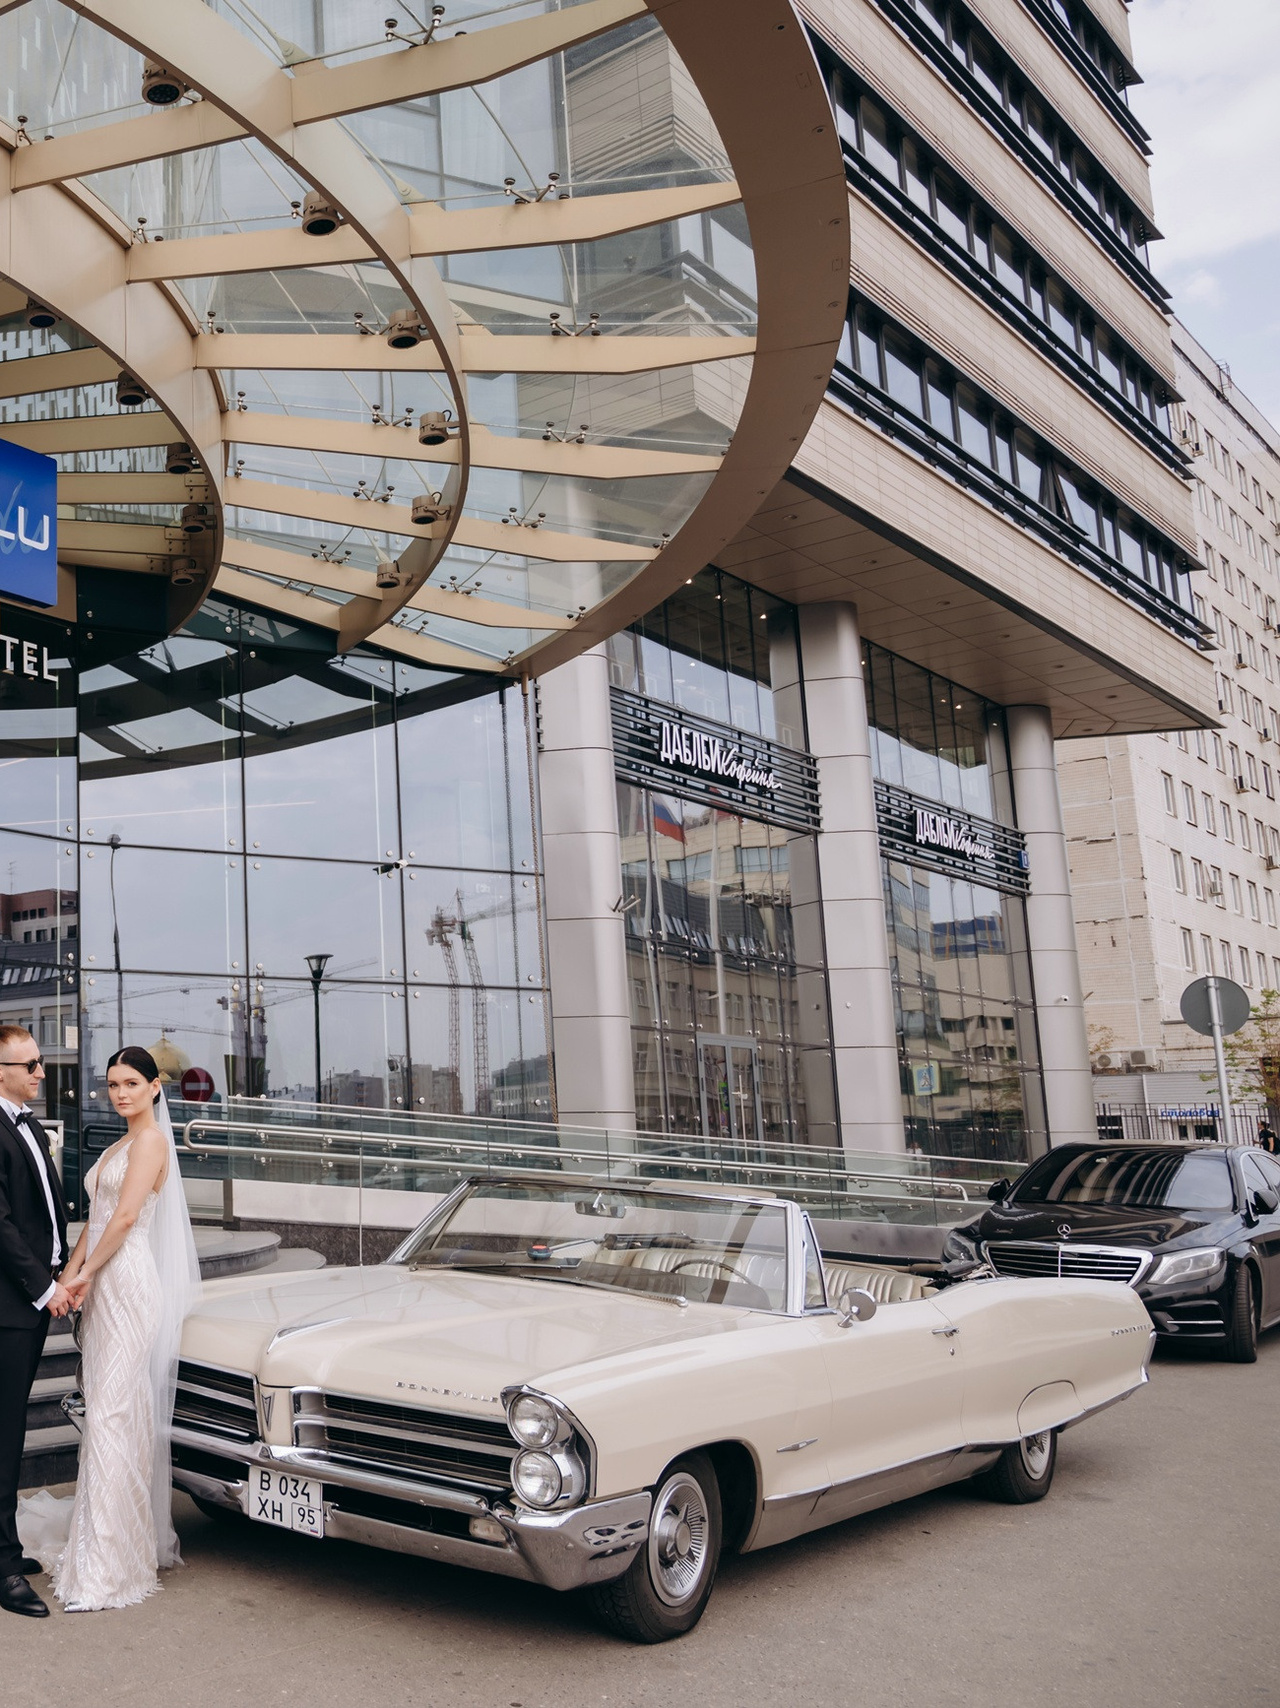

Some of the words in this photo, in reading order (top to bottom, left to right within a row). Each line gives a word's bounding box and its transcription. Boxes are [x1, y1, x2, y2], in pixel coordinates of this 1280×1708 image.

[660, 721, 723, 776] ДАБЛБИ
[720, 746, 783, 788] Кофейня
[915, 809, 956, 851] ДАБЛБИ
[260, 1470, 271, 1491] B
[279, 1476, 310, 1503] 034
[258, 1496, 283, 1522] XH
[297, 1507, 316, 1525] 95
